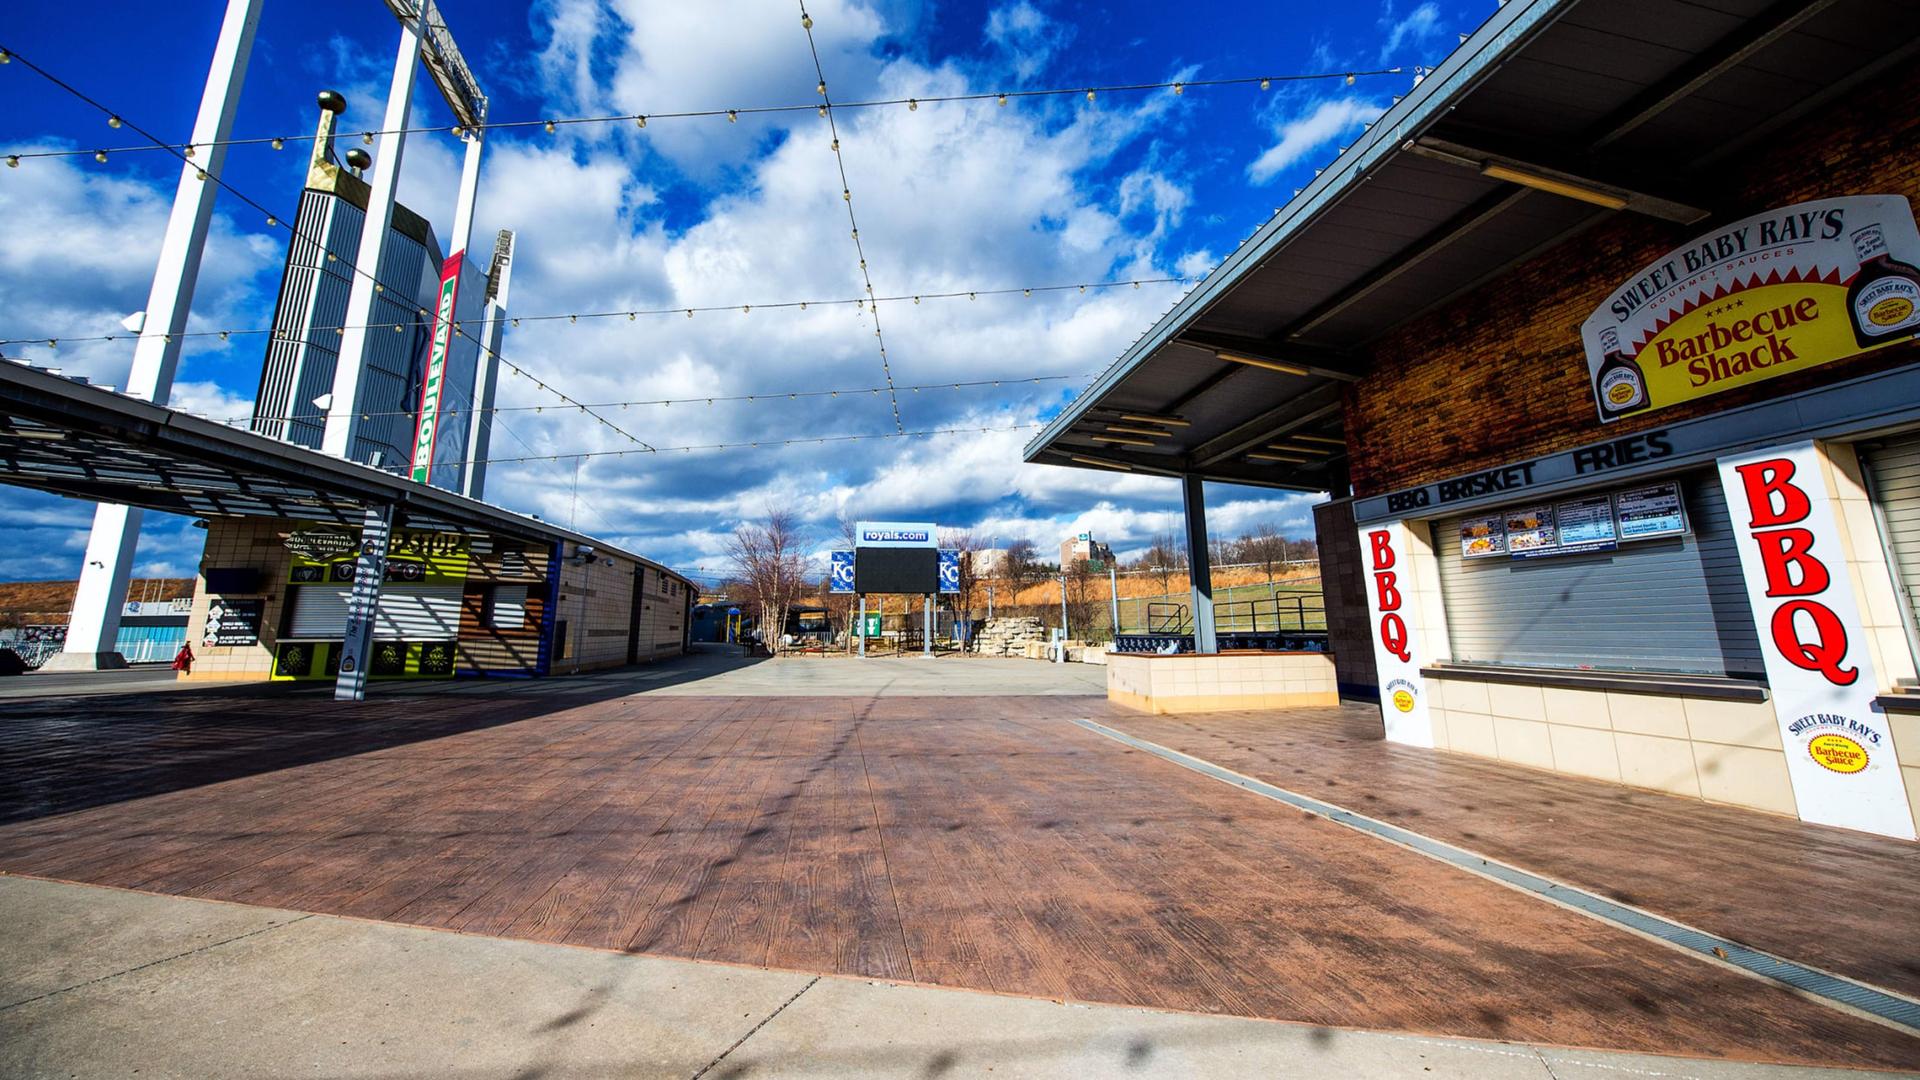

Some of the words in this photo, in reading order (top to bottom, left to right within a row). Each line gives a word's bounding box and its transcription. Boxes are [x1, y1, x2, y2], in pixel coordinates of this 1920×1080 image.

[1610, 256, 1684, 323] SWEET
[1682, 227, 1749, 274] BABY
[1758, 208, 1845, 246] RAY'S
[1650, 270, 1716, 310] GOURMET
[1726, 248, 1795, 271] SAUCES
[1654, 297, 1819, 368] Barbecue
[414, 292, 451, 470] BOULEVARD
[1686, 335, 1799, 388] Shack
[1387, 491, 1430, 514] BBQ
[1438, 461, 1537, 503] BRISKET
[1572, 430, 1674, 474] FRIES
[407, 533, 460, 555] STOP
[865, 530, 926, 542] royals.com
[832, 561, 854, 583] KC
[938, 561, 959, 583] KC
[1368, 529, 1411, 663] BBQ
[1735, 458, 1858, 686] BBQ
[1788, 715, 1817, 737] SWEET
[1817, 713, 1847, 726] BABY
[1849, 718, 1882, 744] RAY'S
[1815, 746, 1861, 760] Barbecue
[1825, 756, 1854, 766] Sauce
